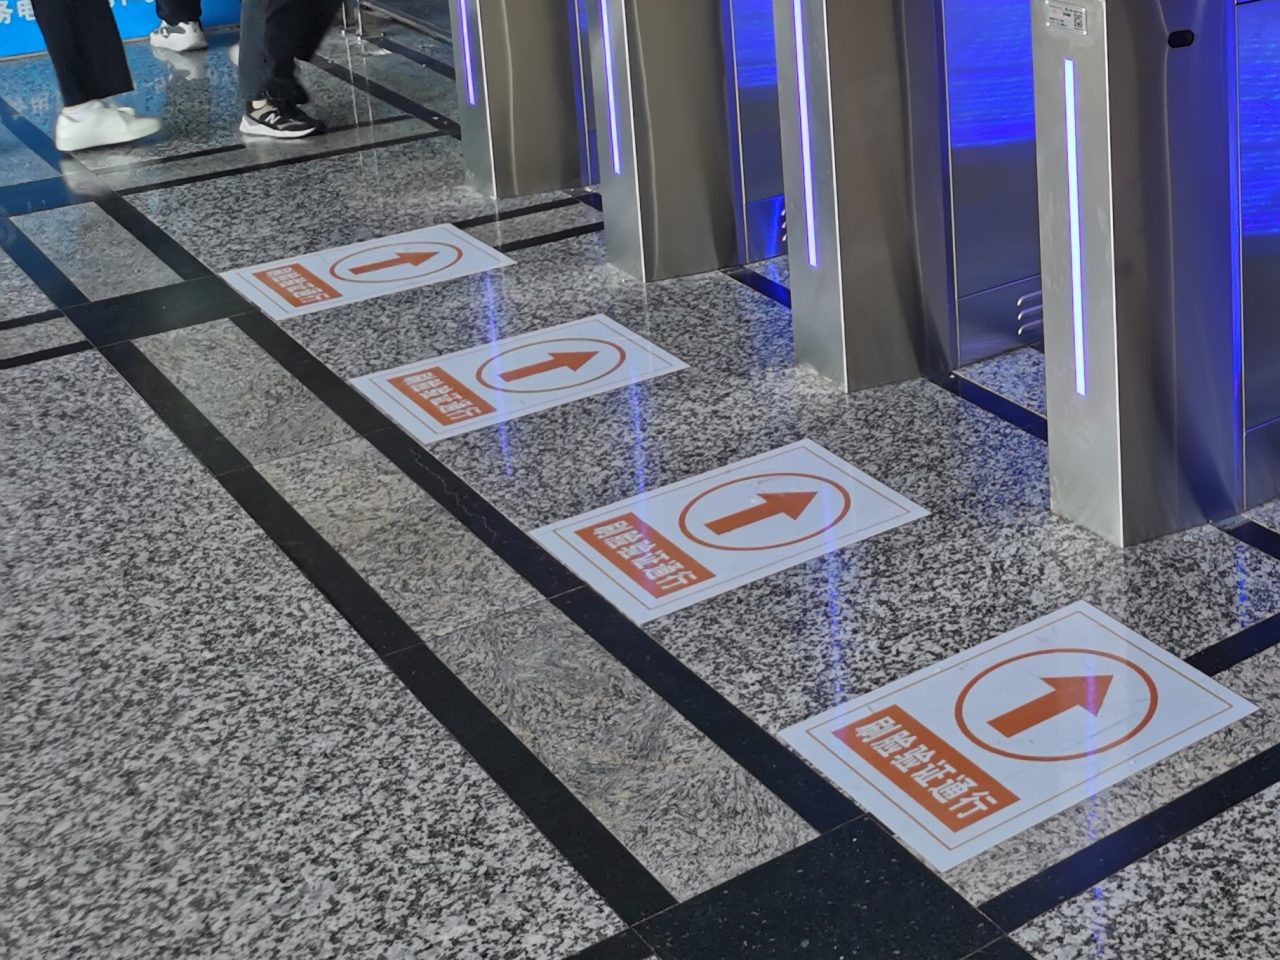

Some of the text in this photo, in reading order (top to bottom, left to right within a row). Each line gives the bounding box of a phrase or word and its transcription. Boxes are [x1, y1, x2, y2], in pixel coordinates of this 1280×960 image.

[855, 716, 998, 819] 刷脸验证通行
